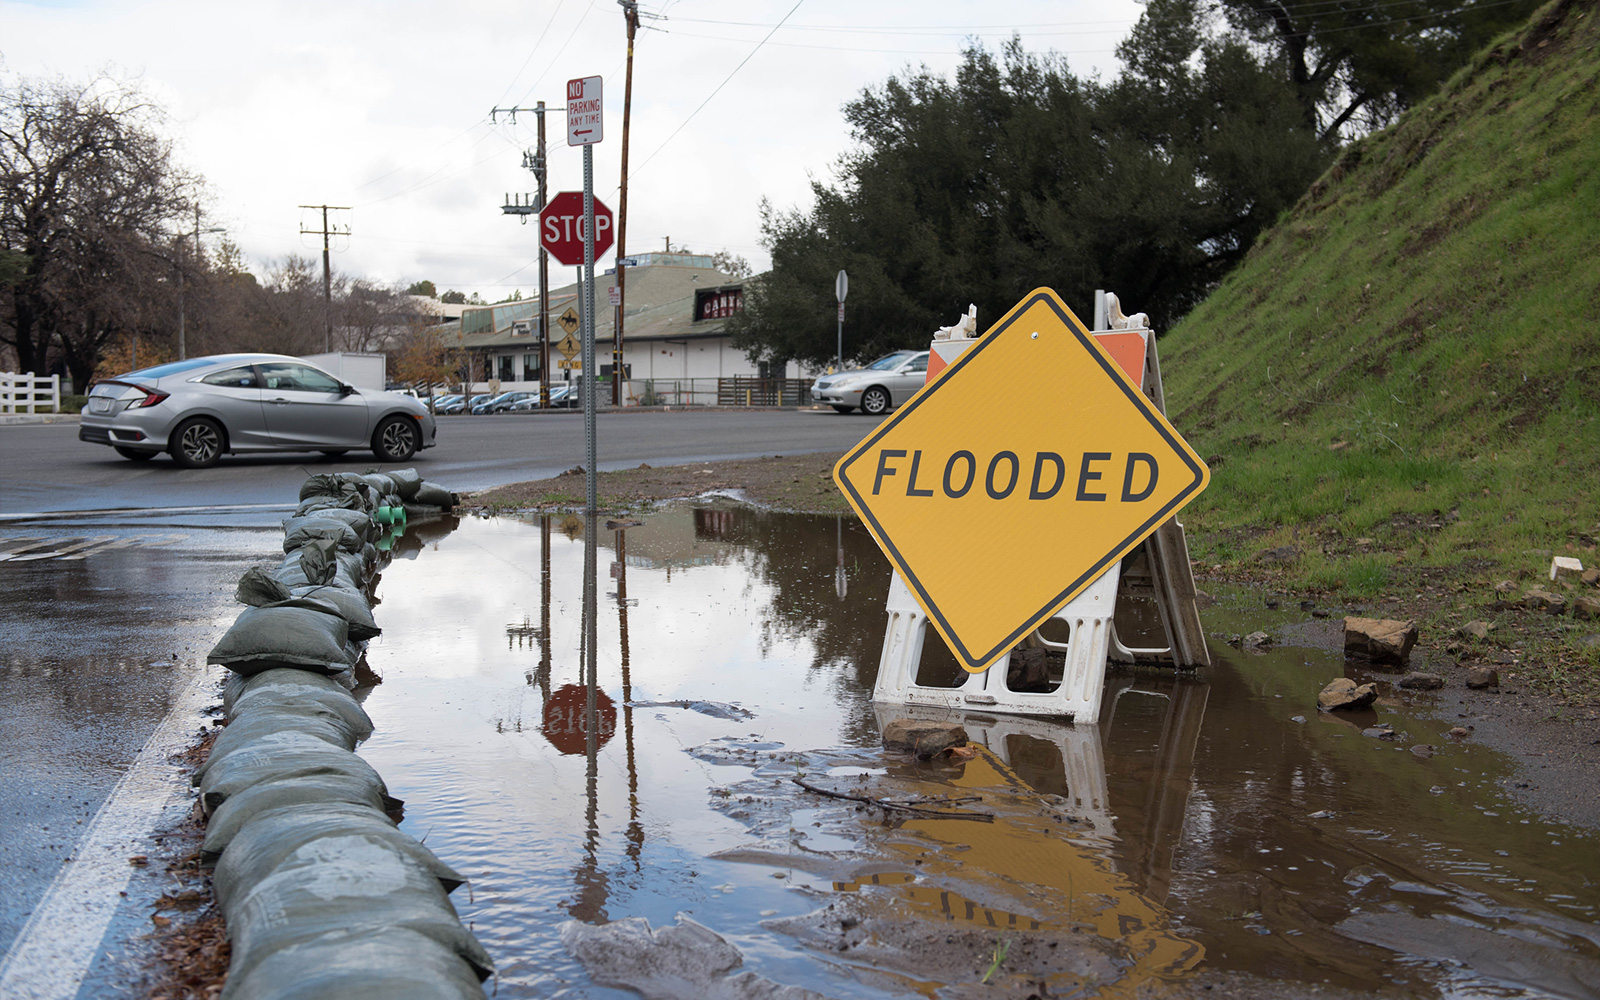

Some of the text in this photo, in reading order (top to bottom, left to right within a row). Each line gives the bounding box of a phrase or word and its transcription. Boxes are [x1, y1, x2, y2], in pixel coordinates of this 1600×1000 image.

[569, 81, 582, 97] NO
[570, 99, 600, 115] PARKING
[570, 113, 600, 127] ANY TIME
[545, 214, 610, 242] STOP
[872, 449, 1159, 503] FLOODED
